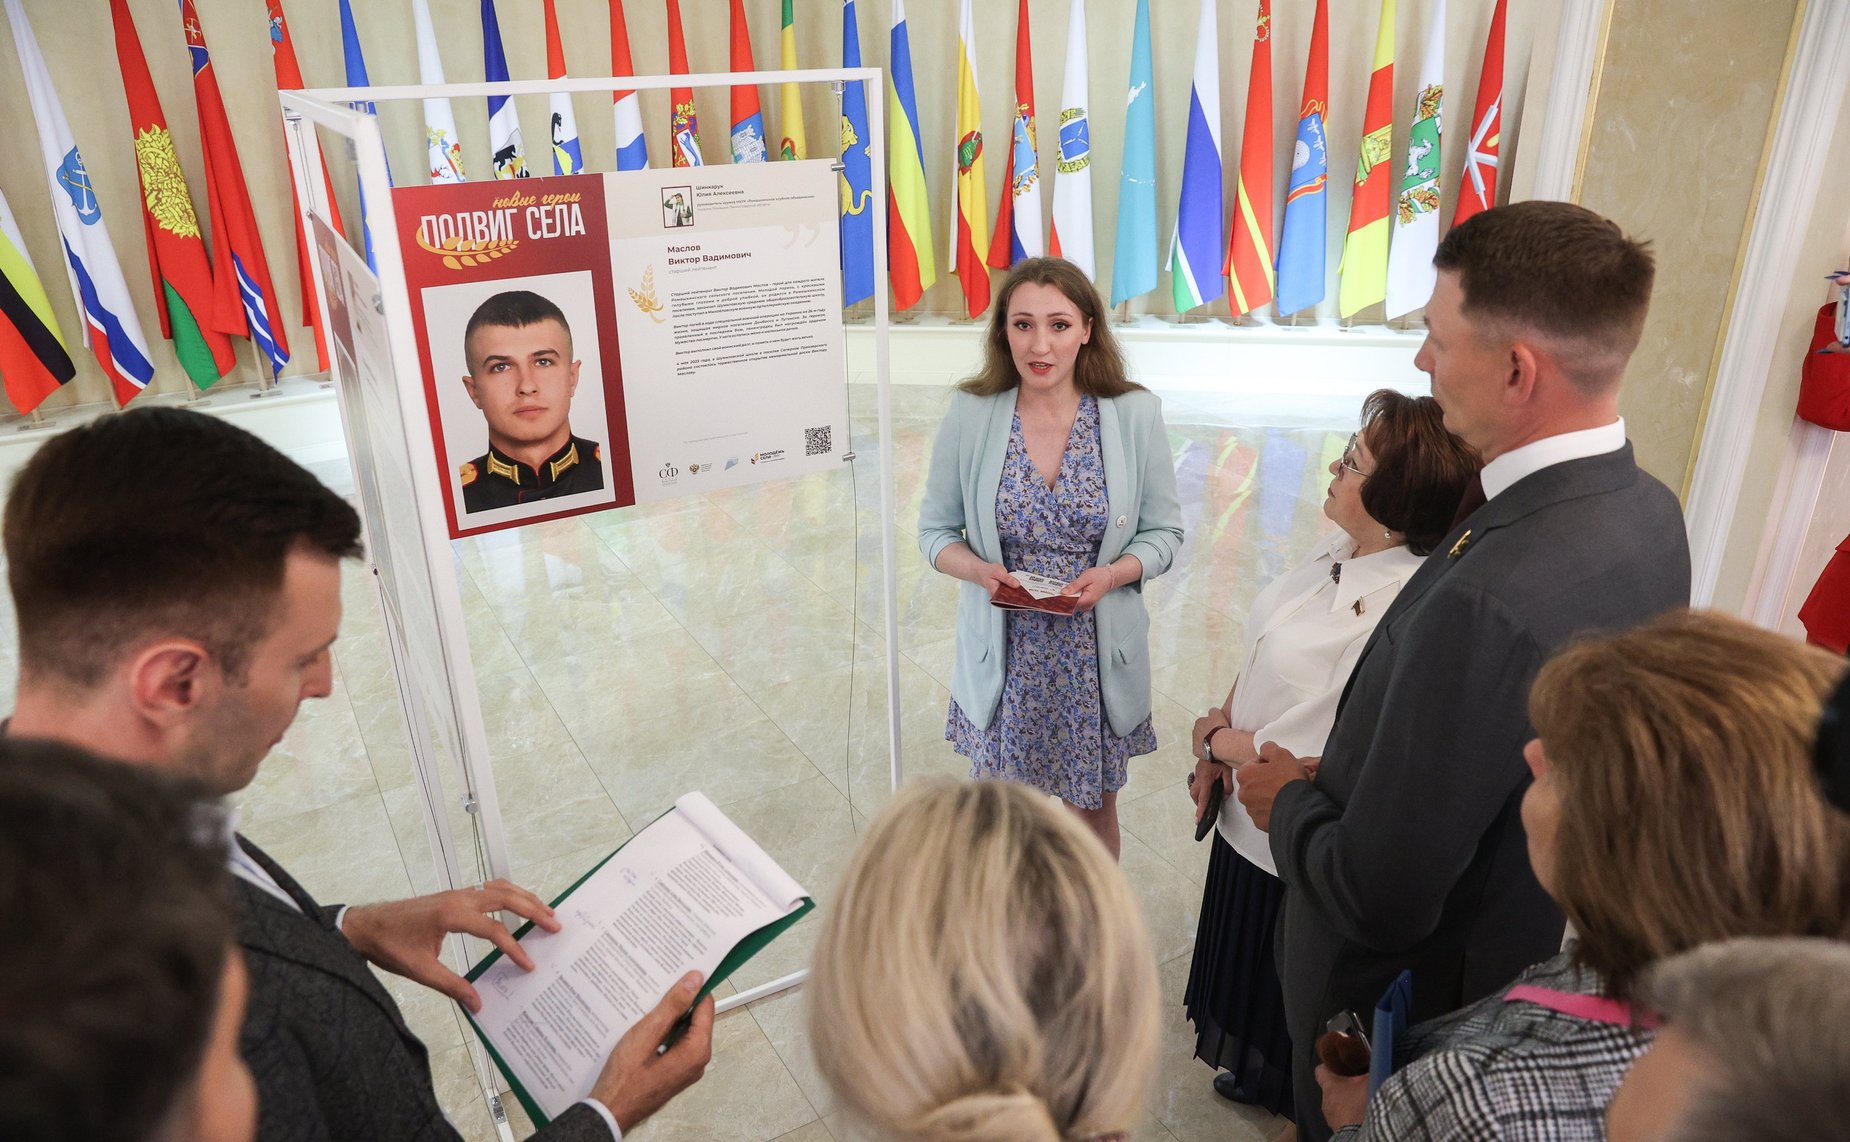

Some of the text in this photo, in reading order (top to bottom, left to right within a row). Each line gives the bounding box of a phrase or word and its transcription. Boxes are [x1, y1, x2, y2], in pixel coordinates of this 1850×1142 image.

[494, 190, 582, 210] новые герои
[422, 203, 586, 252] ПОДВИГ СЕЛА
[667, 244, 701, 254] Маслов
[668, 252, 752, 266] Виктор Вадимович
